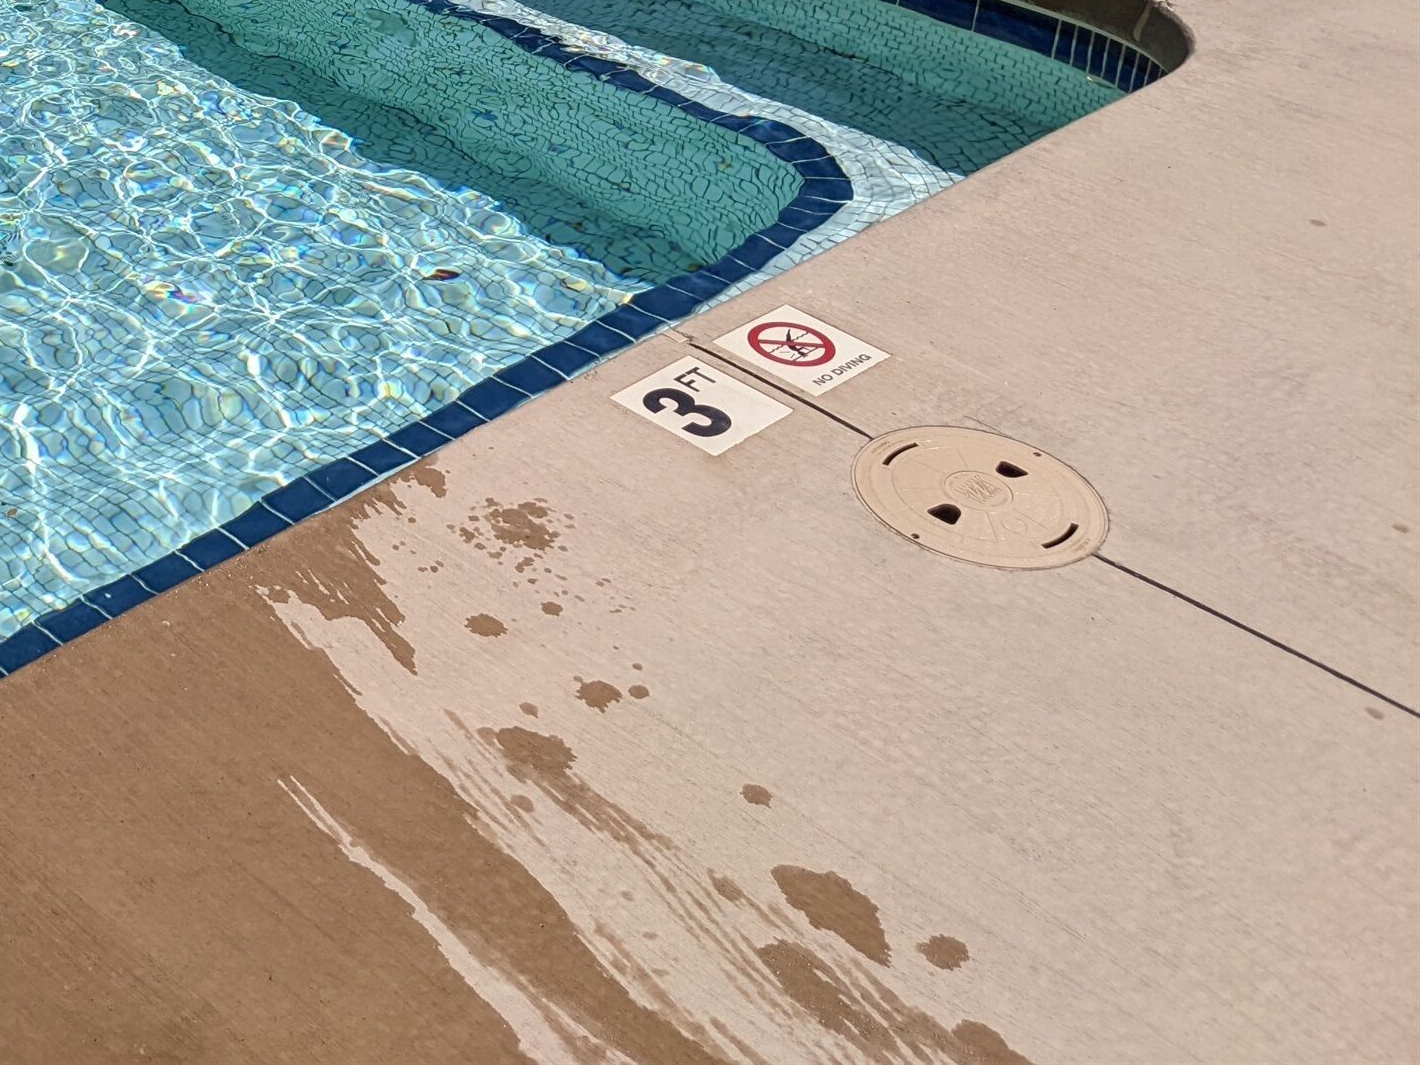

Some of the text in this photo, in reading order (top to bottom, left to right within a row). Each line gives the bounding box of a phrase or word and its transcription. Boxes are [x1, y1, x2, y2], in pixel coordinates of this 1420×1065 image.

[812, 354, 872, 386] NO DIVING
[642, 367, 732, 438] 3 FT
